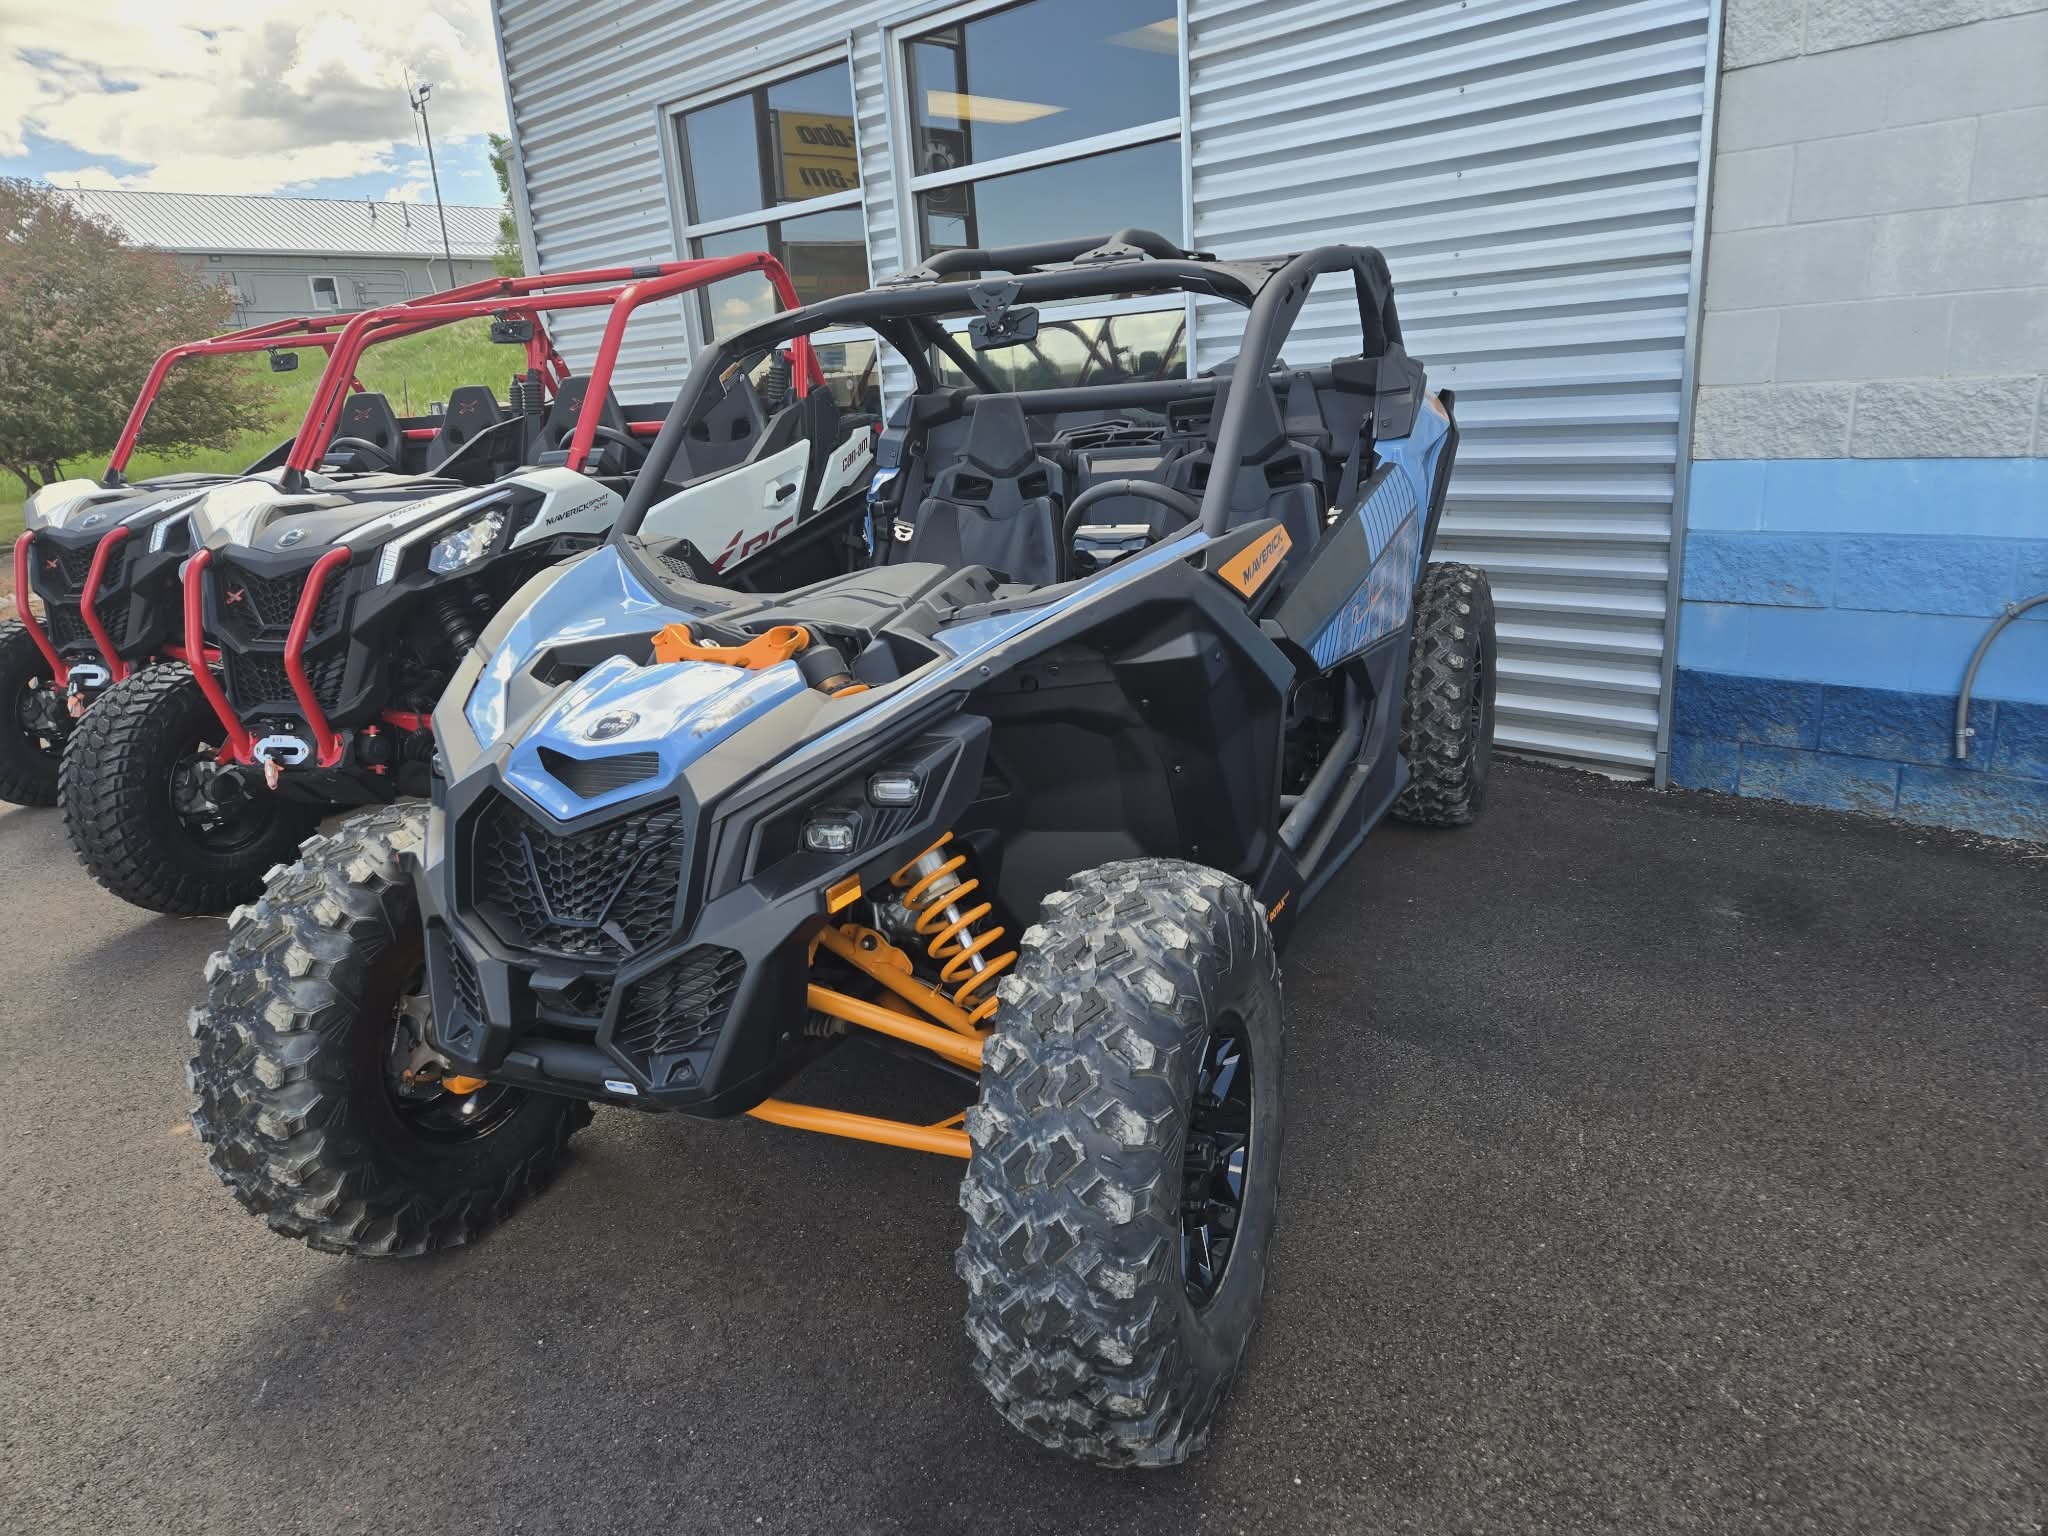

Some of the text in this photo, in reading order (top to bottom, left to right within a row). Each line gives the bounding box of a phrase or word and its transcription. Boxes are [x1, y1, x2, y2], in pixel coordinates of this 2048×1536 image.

[842, 436, 868, 472] can-am
[545, 502, 589, 526] MAVERICK
[1242, 528, 1284, 585] MAVERICK
